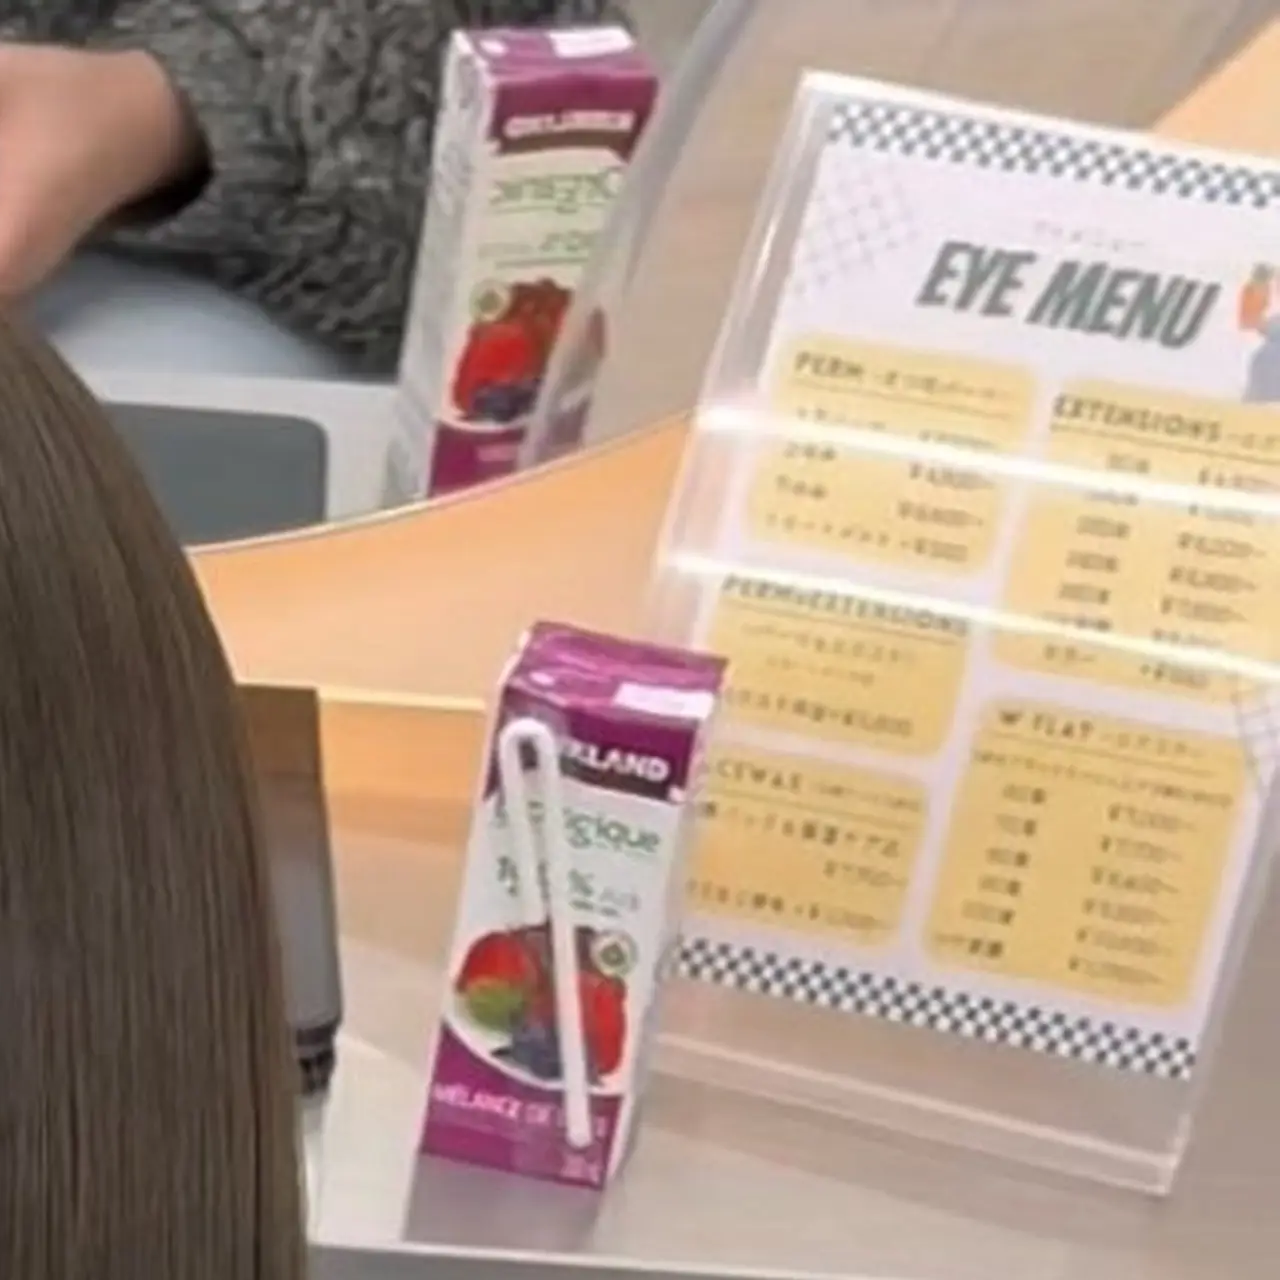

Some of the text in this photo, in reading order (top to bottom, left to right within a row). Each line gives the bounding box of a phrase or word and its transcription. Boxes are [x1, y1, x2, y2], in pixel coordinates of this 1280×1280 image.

[915, 240, 1222, 349] EYE MENU
[1052, 393, 1221, 443] EXTENSIONS
